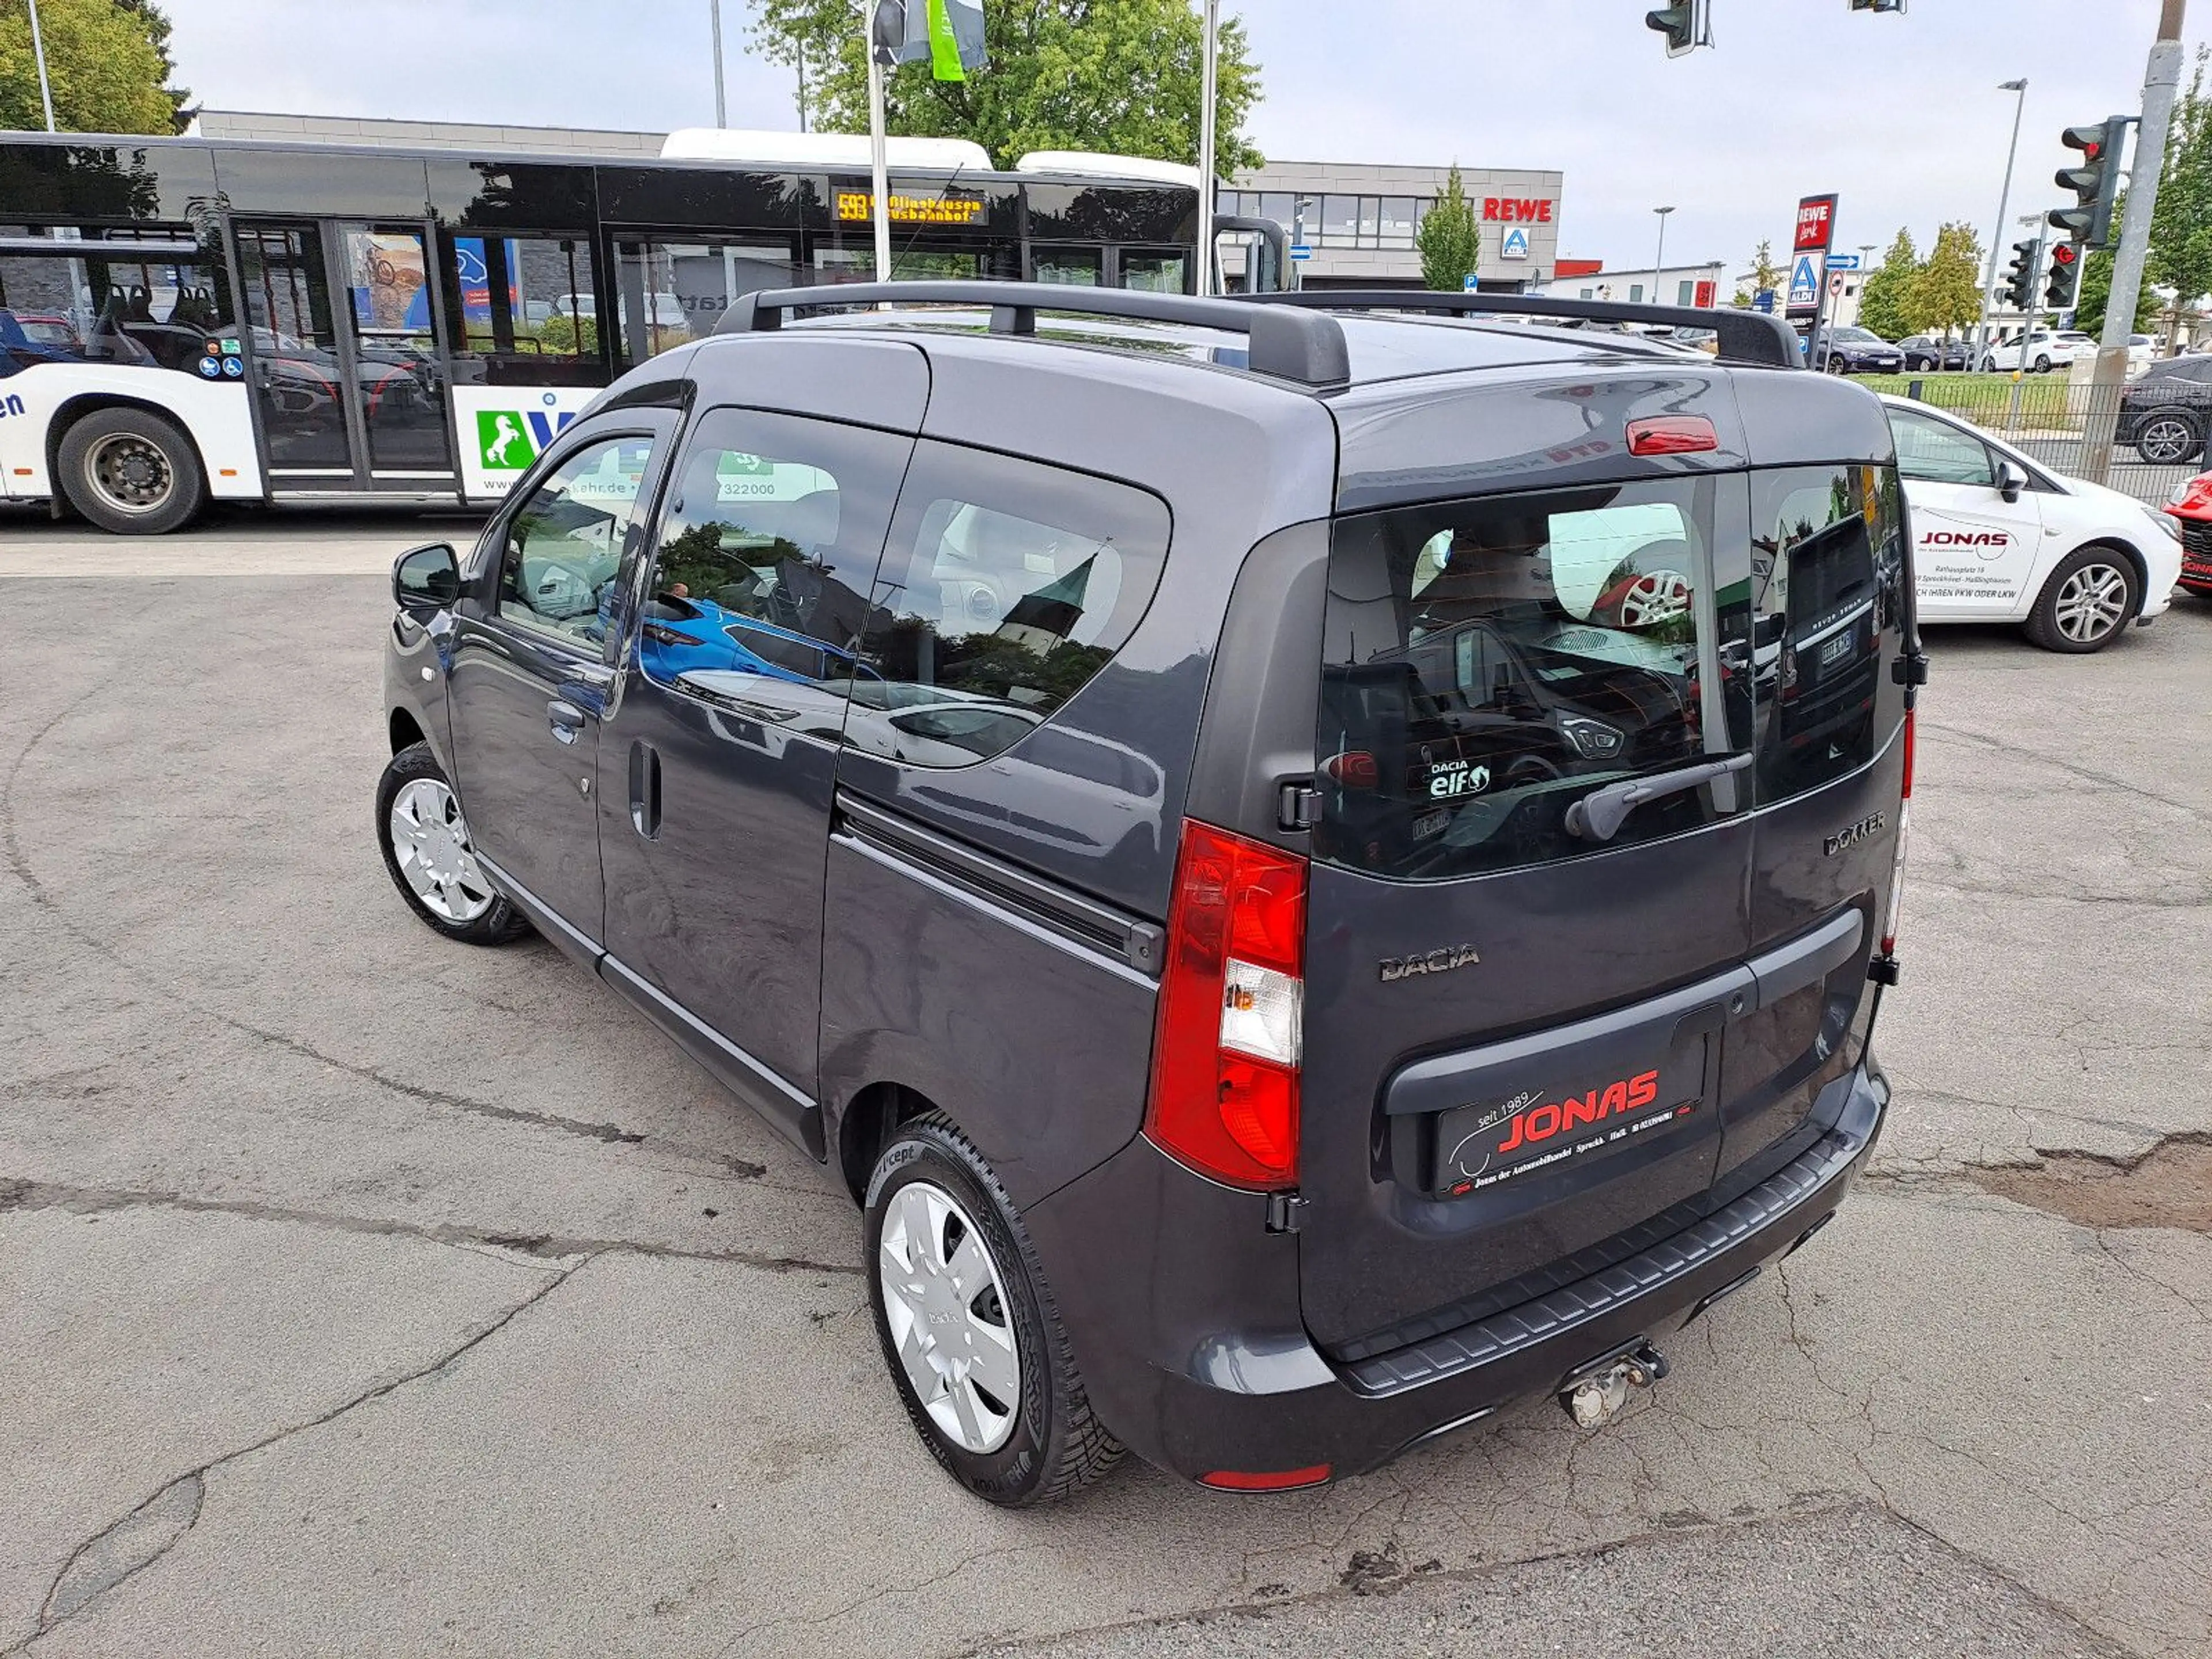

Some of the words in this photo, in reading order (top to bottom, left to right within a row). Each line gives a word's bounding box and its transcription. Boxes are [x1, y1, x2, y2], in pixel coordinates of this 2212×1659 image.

[839, 194, 868, 219] 593
[1483, 198, 1552, 222] REWE
[1791, 291, 1813, 301] ALDI
[724, 484, 775, 494] 322000
[1919, 532, 2008, 546] JONAS
[1928, 589, 1953, 597] IHREN
[1955, 589, 1974, 598] PKW
[1974, 590, 1997, 598] ODER
[1998, 590, 2017, 599] LKW
[1431, 760, 1469, 774] DACIA
[1431, 771, 1468, 796] elf
[1824, 810, 1886, 856] DOKKER
[1378, 944, 1480, 982] DACIA
[1478, 1110, 1497, 1127] seit
[1501, 1092, 1529, 1116] 1989
[1499, 1069, 1659, 1153] JONAS
[1475, 1175, 1497, 1188] Jonas
[1498, 1170, 1511, 1181] der
[1512, 1147, 1572, 1176] Automobilhandel
